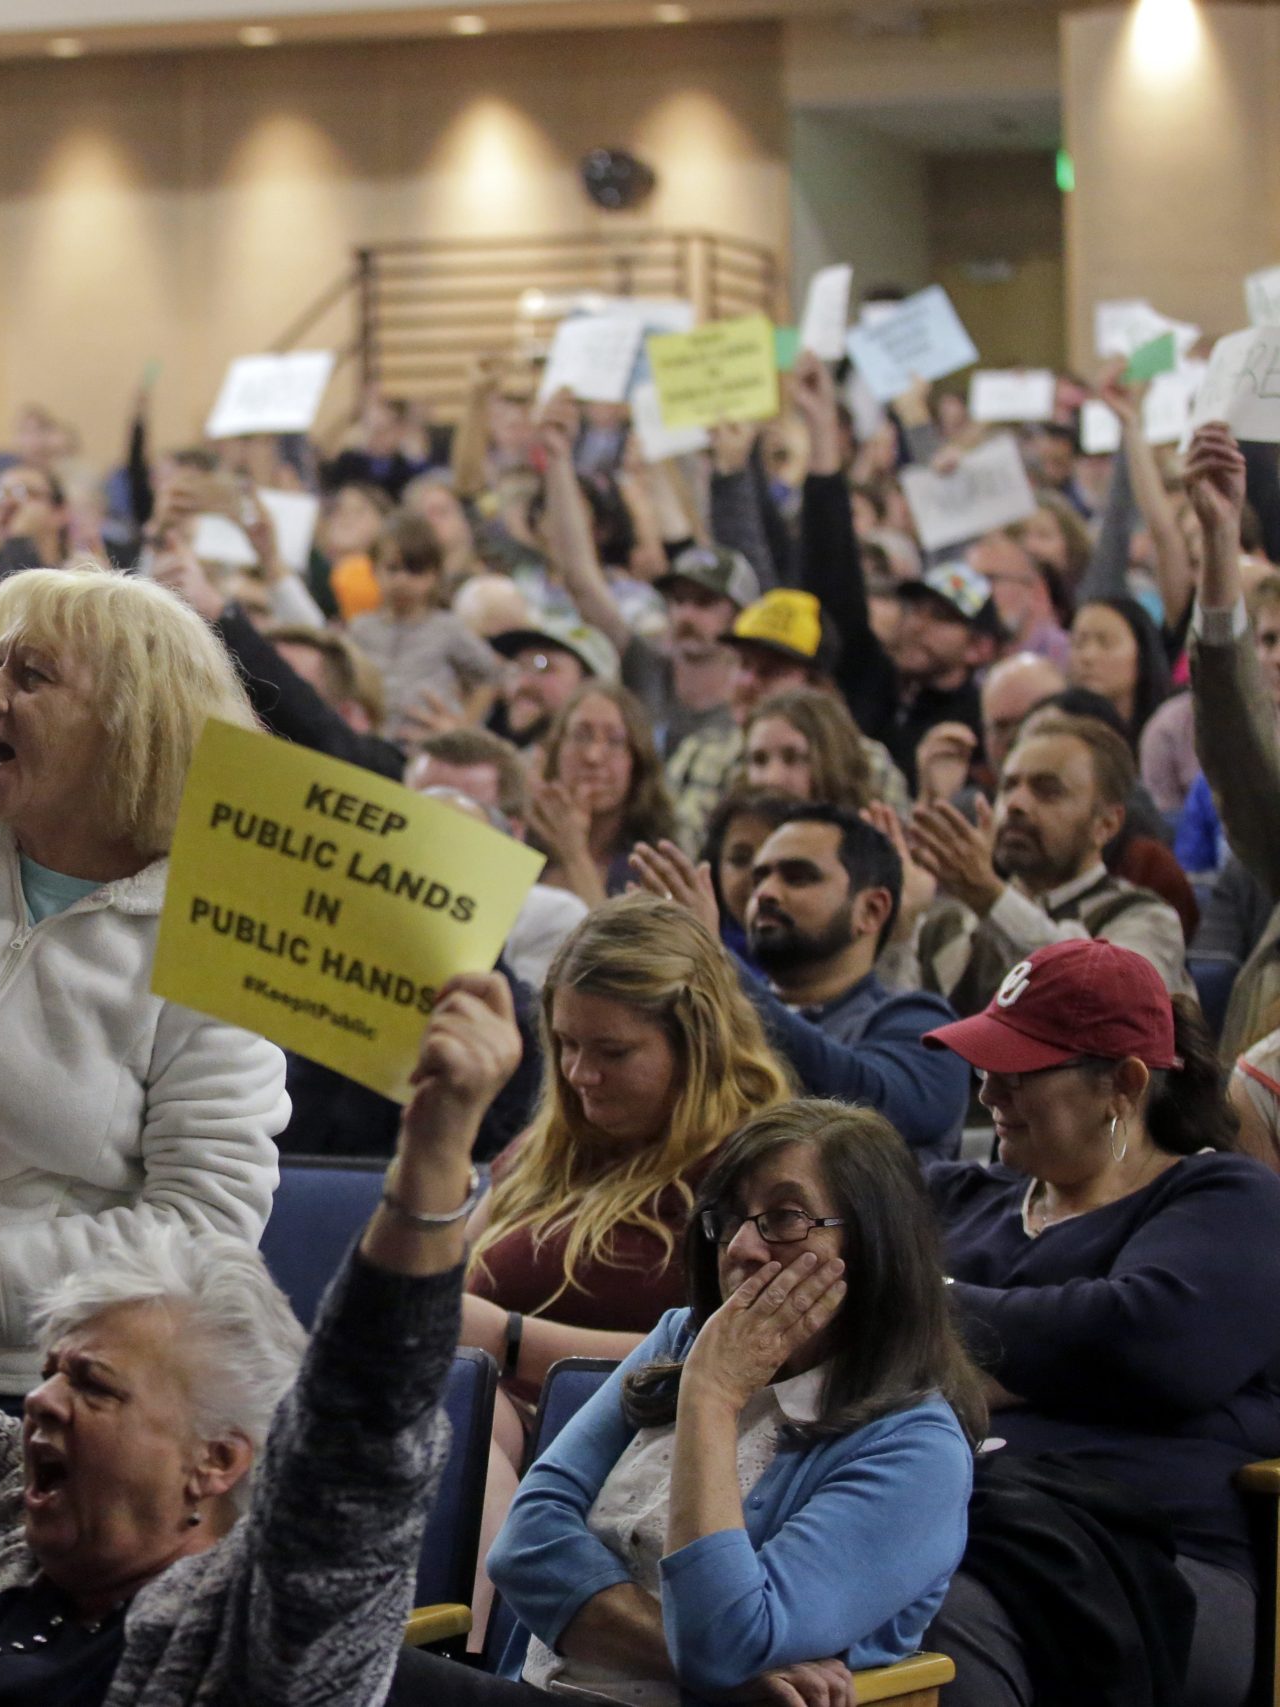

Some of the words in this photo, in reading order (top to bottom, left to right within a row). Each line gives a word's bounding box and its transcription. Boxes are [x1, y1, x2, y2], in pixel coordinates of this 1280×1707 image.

[304, 783, 409, 837] KEEP
[209, 803, 339, 869] PUBLIC
[345, 852, 478, 924] LANDS
[303, 889, 342, 926] IN
[189, 897, 312, 966] PUBLIC
[320, 946, 438, 1015] HANDS
